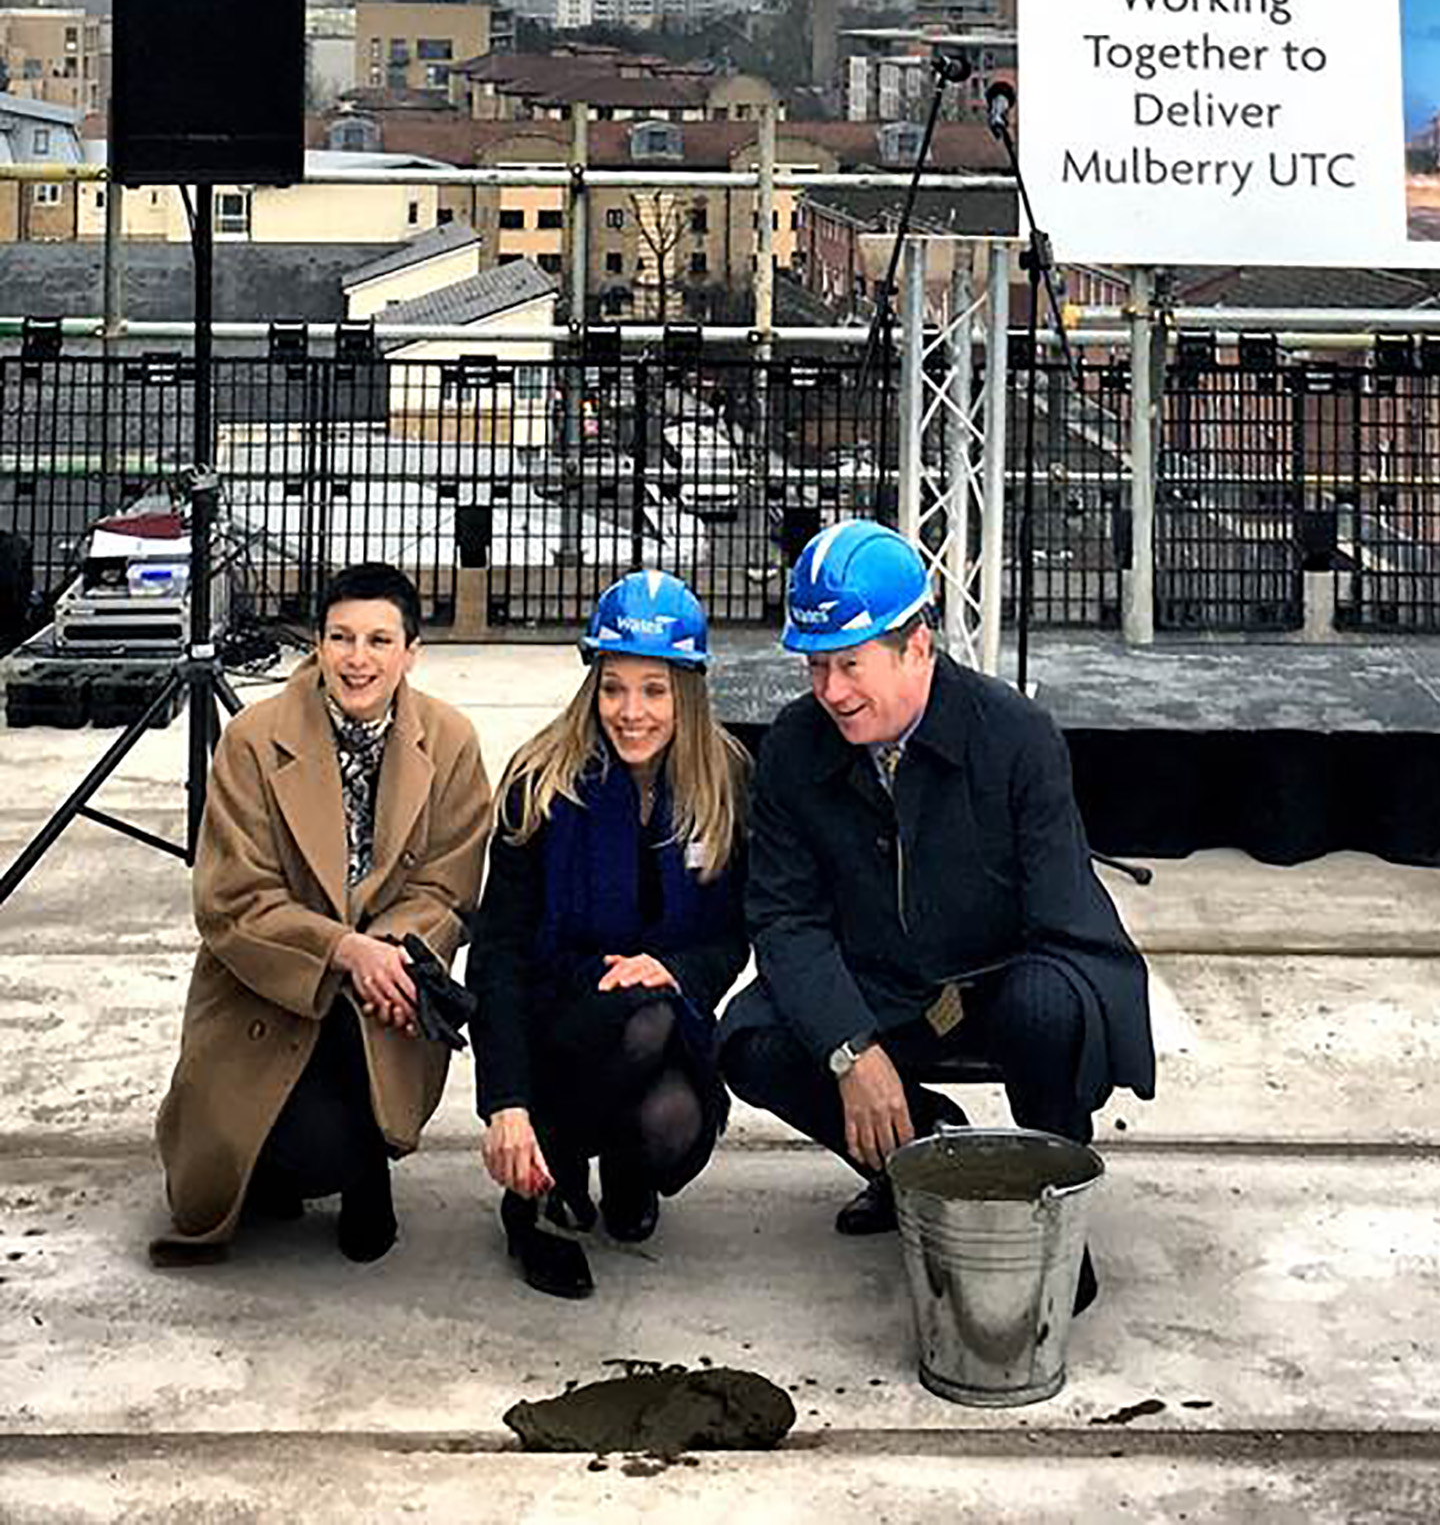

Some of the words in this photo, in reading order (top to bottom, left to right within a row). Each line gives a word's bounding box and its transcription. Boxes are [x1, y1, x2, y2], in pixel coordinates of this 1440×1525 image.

[1082, 31, 1270, 81] Together
[1281, 40, 1328, 73] to
[1133, 88, 1283, 129] Deliver
[1061, 145, 1254, 198] Mulberry
[1268, 151, 1356, 189] UTC
